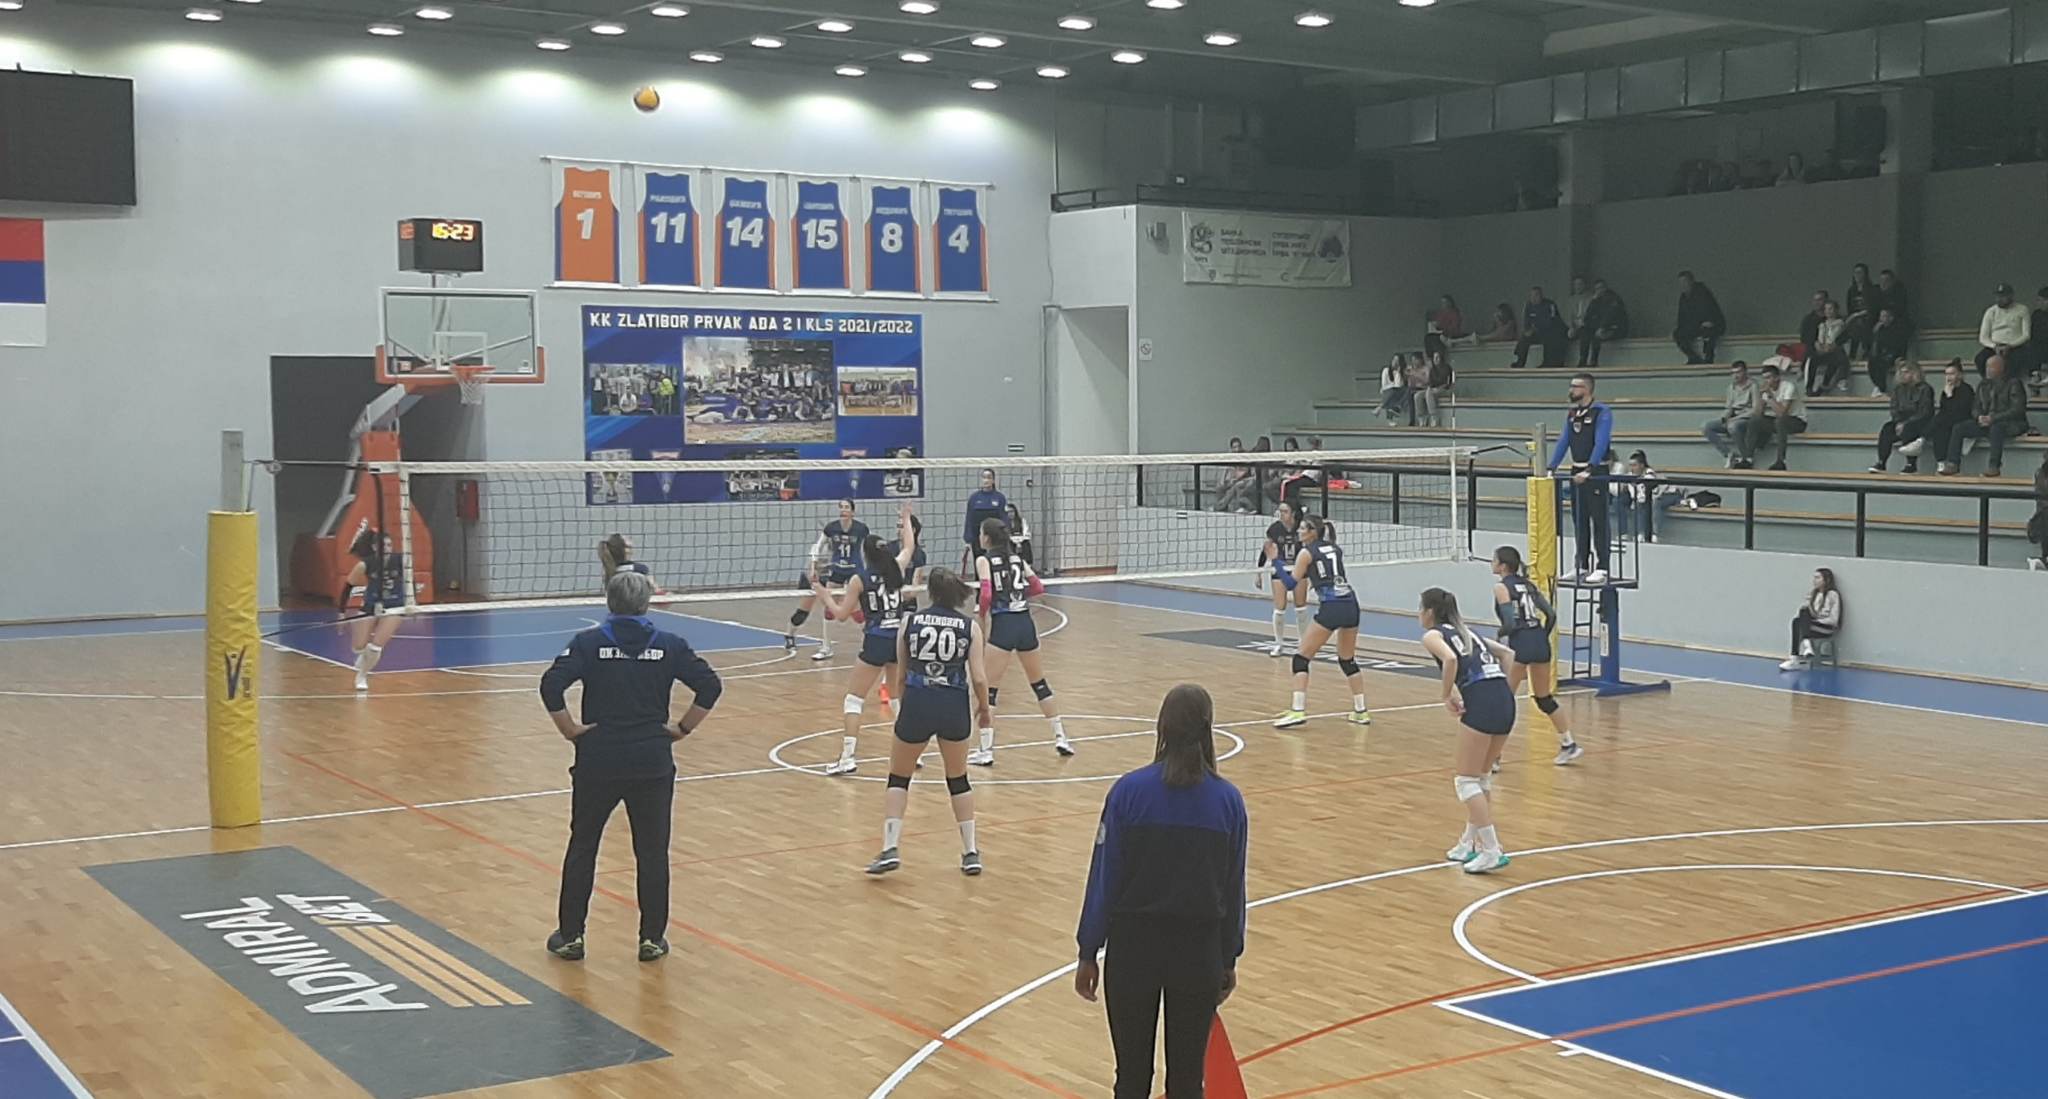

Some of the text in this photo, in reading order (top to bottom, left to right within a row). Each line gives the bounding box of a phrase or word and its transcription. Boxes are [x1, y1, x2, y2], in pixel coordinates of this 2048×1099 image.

[576, 207, 595, 240] 1
[650, 212, 687, 243] 11
[726, 216, 764, 248] 14
[802, 218, 839, 250] 15
[880, 222, 903, 253] 8
[948, 224, 969, 253] 4
[590, 312, 611, 327] KK
[617, 313, 689, 329] ZLATIBOR
[694, 315, 742, 330] PRVAK
[783, 317, 793, 331] 2
[806, 318, 834, 332] KLS
[838, 319, 914, 334] 2021/2022
[918, 626, 956, 662] 20
[275, 893, 392, 924] BET
[179, 896, 430, 1014] ADMIRAL
